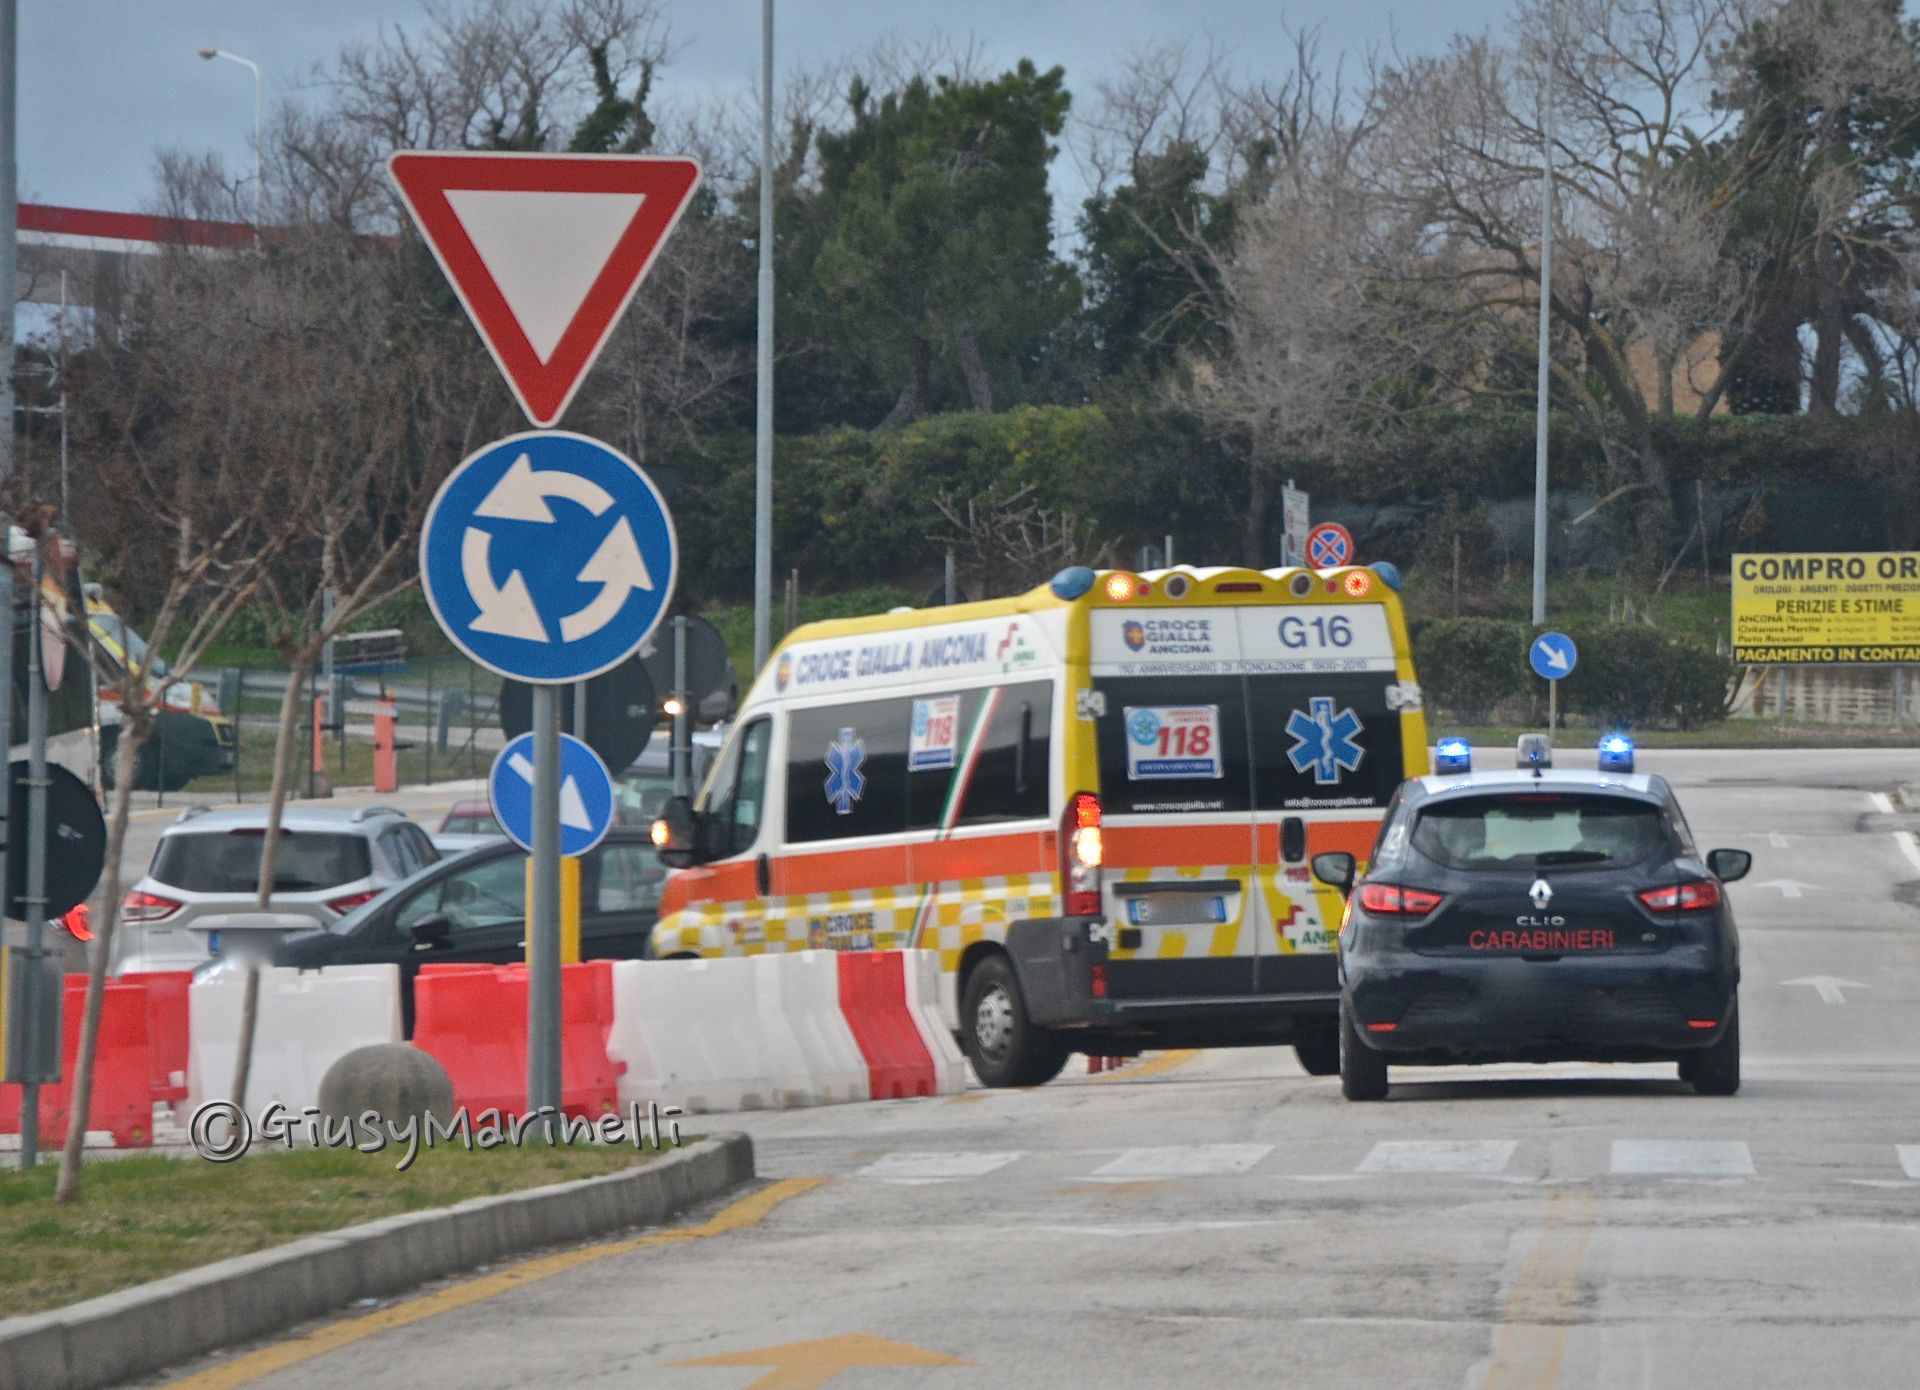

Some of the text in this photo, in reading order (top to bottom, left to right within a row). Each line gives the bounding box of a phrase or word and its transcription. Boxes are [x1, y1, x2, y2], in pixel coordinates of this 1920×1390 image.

[1740, 556, 1920, 581] COMPRO OR
[1800, 584, 1837, 593] ARGENTI
[1776, 599, 1904, 614] PERIZIE E STIME
[1145, 620, 1210, 630] CROCE
[1278, 615, 1353, 648] G16
[1146, 632, 1211, 642] GIALLA
[1149, 645, 1212, 654] ANCONA
[1735, 648, 1834, 662] PAGAMENTO
[1838, 648, 1856, 661] IN
[796, 650, 850, 684] CROCE
[856, 640, 912, 677] GIALLA
[918, 632, 988, 670] ANCONA
[925, 714, 954, 747] 118
[1157, 725, 1211, 757] 118
[827, 911, 874, 934] CROCE
[1516, 916, 1566, 926] CLIO
[1302, 930, 1338, 944] ANP
[1468, 930, 1615, 950] CARABINIERI
